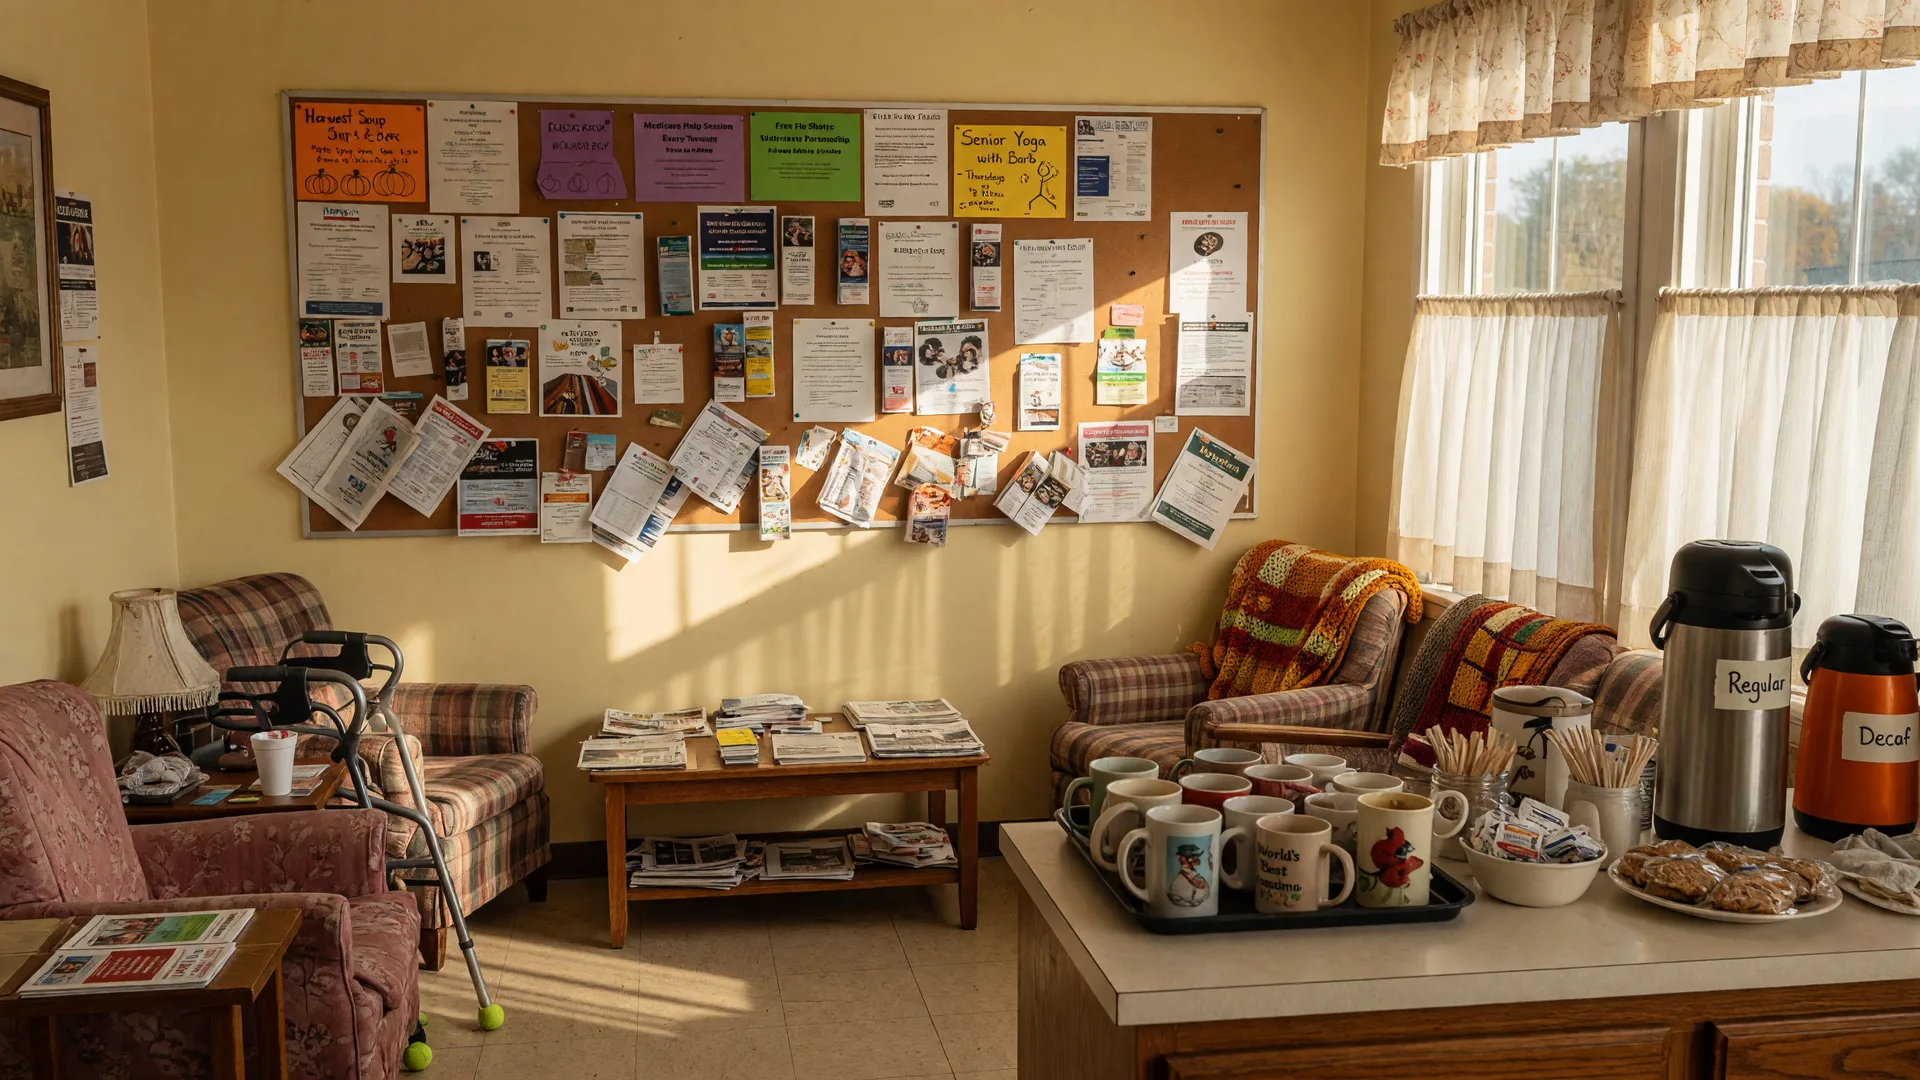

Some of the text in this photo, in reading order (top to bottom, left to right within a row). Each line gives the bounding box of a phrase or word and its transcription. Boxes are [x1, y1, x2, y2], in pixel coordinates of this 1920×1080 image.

[358, 109, 386, 128] Soup
[643, 121, 733, 131] Medicare Help Session
[775, 122, 792, 130] Free
[662, 134, 685, 143] Every
[961, 129, 1046, 153] Senior Yoga
[977, 150, 1036, 164] with Barb
[1728, 670, 1786, 704] Regular
[1858, 725, 1912, 747] Decaf
[1257, 842, 1300, 862] World's
[1260, 859, 1288, 876] Best
